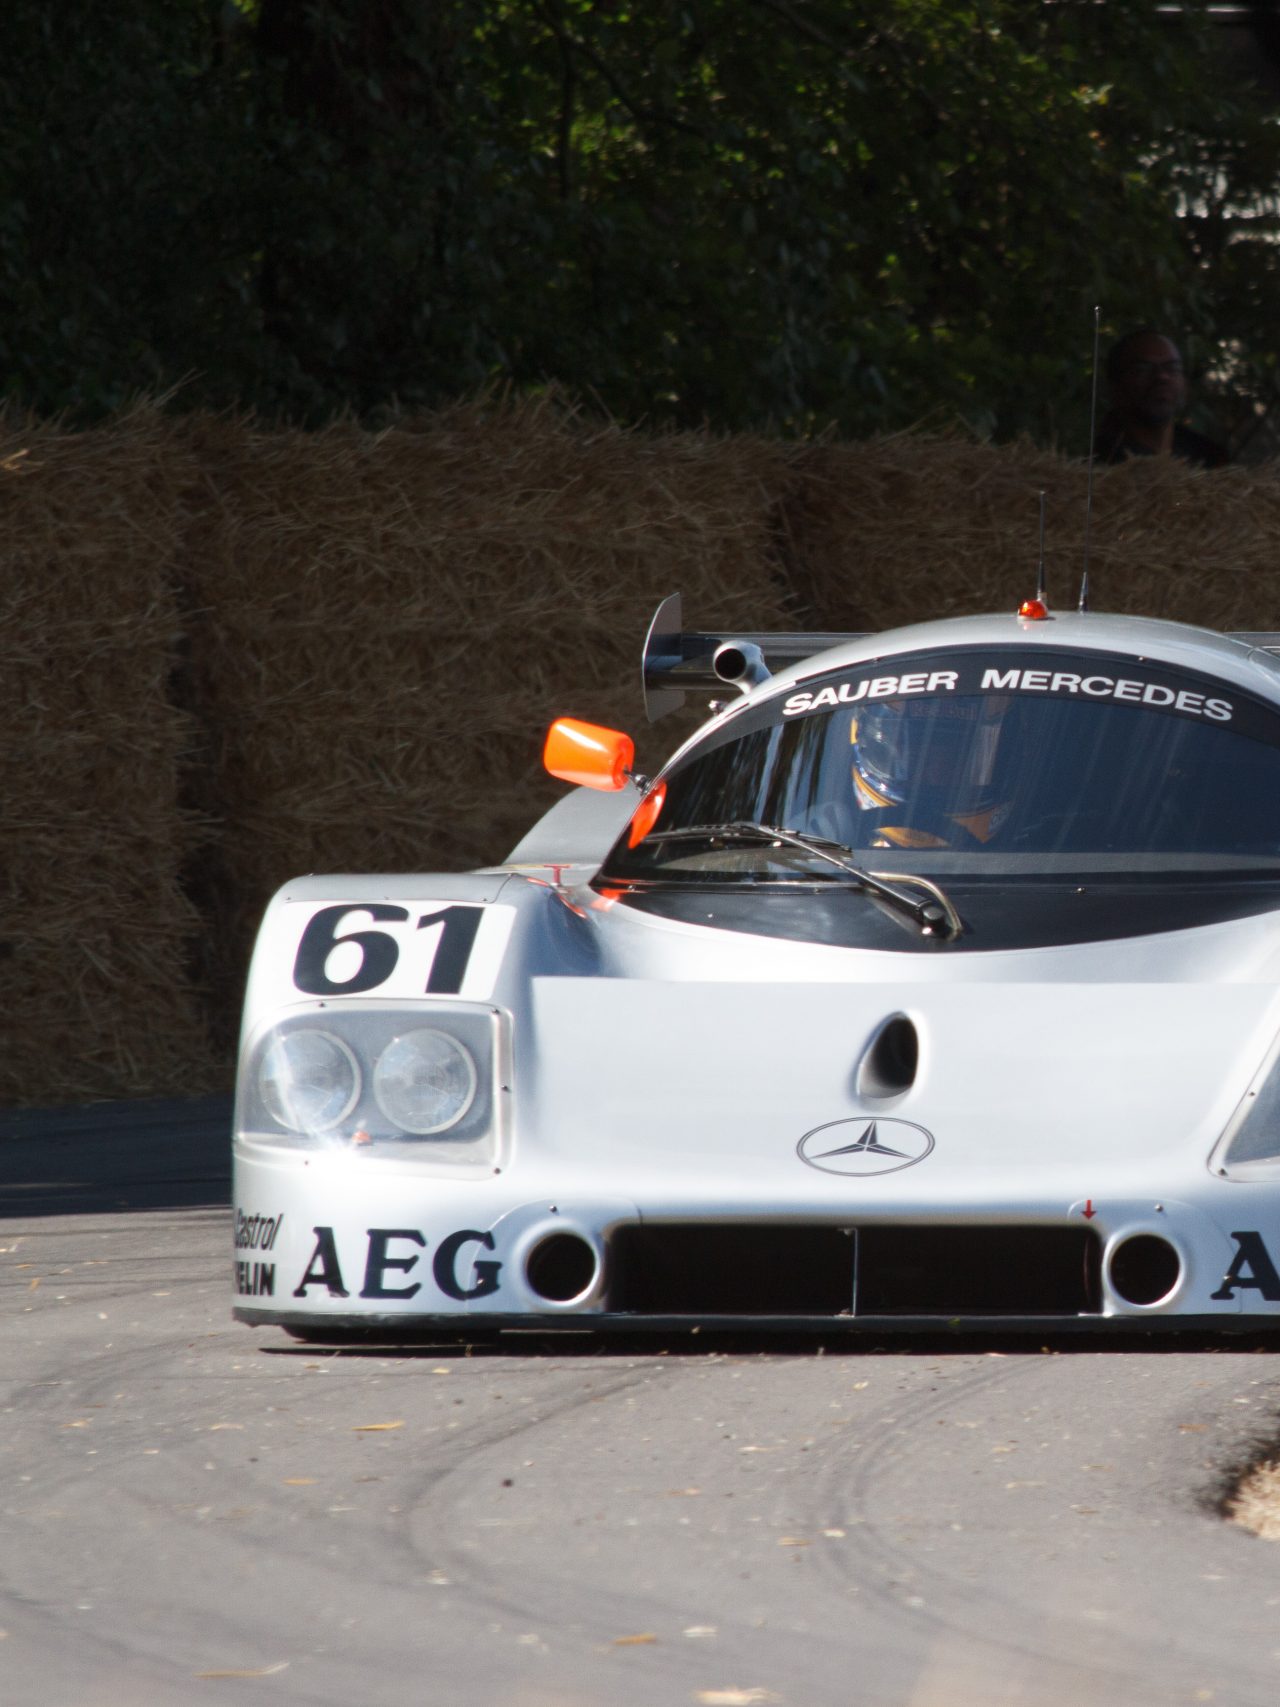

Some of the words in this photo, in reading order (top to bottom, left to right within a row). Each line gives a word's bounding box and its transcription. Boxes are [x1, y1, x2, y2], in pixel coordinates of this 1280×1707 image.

[782, 670, 959, 717] SAUBER
[980, 668, 1234, 722] MERCEDES
[292, 903, 486, 996] 61
[235, 1261, 276, 1297] ELIN
[292, 1226, 503, 1301] AEG
